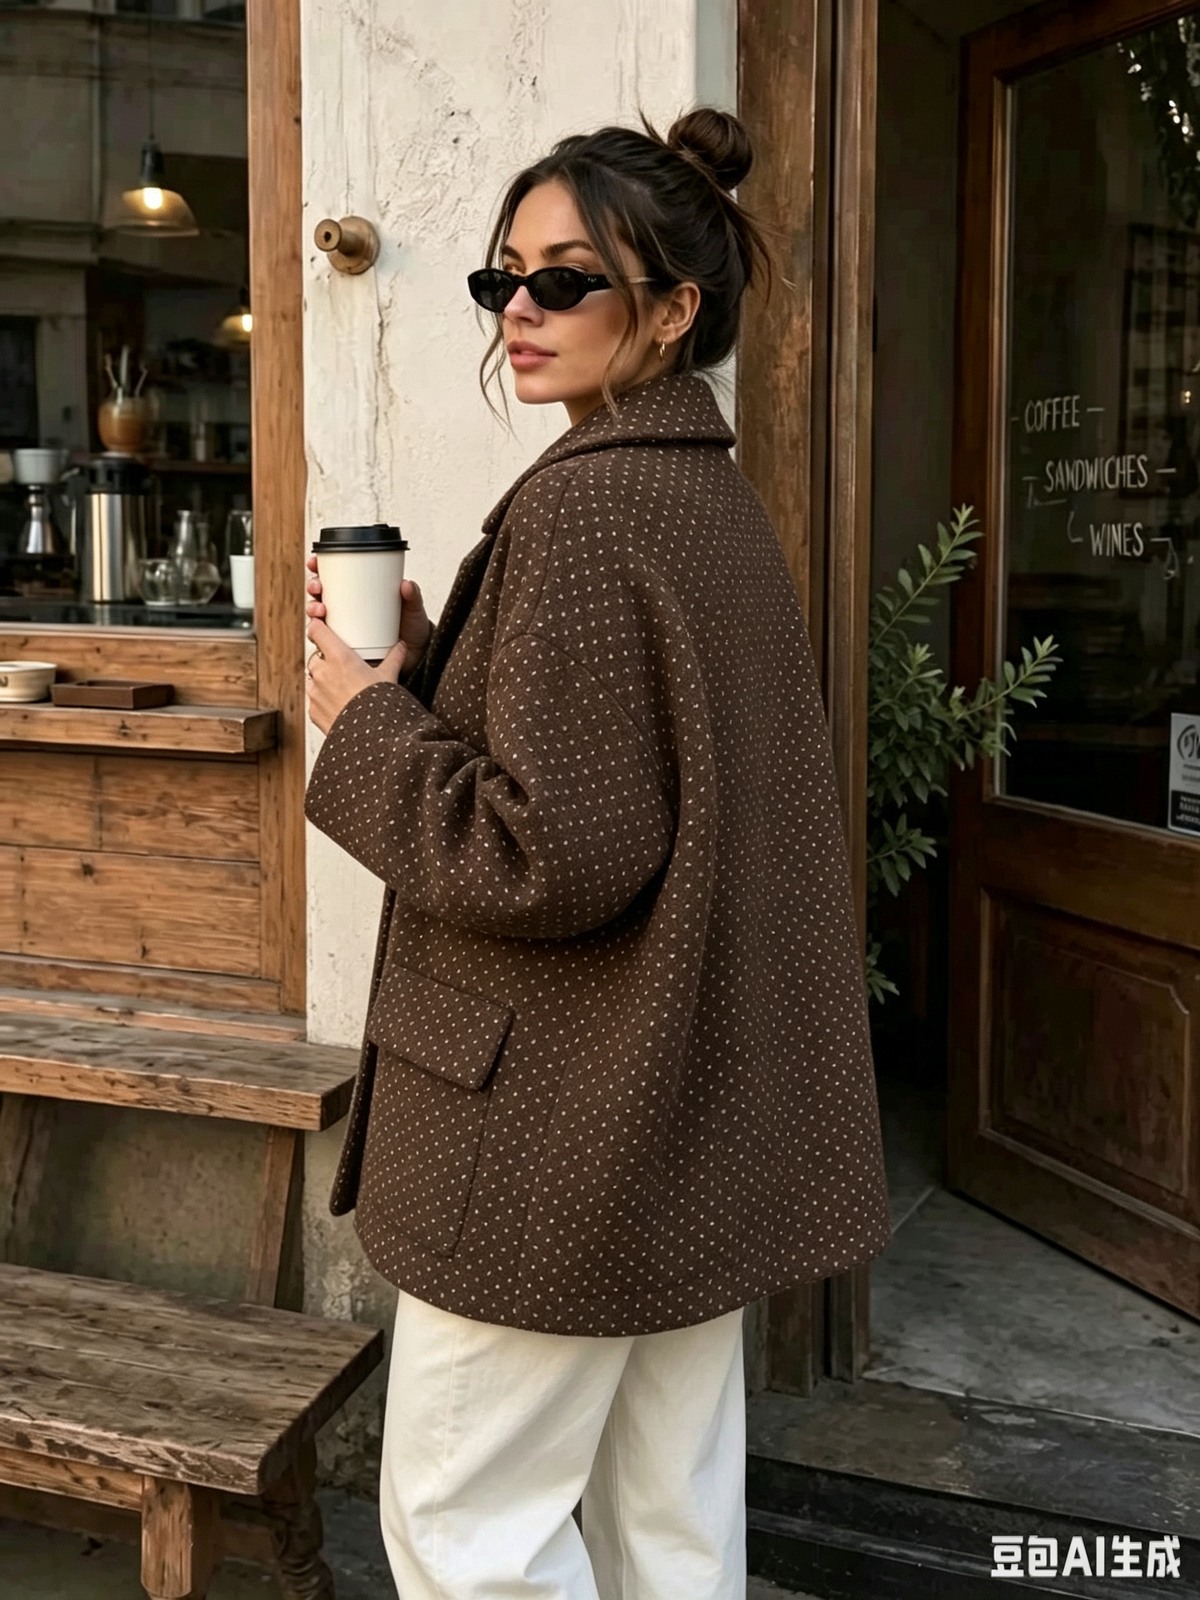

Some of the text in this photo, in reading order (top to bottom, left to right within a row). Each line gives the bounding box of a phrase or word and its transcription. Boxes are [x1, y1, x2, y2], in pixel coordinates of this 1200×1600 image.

[1024, 395, 1080, 433] COFFEE
[1044, 454, 1149, 493] SANDWICHES
[1089, 522, 1144, 557] WINES
